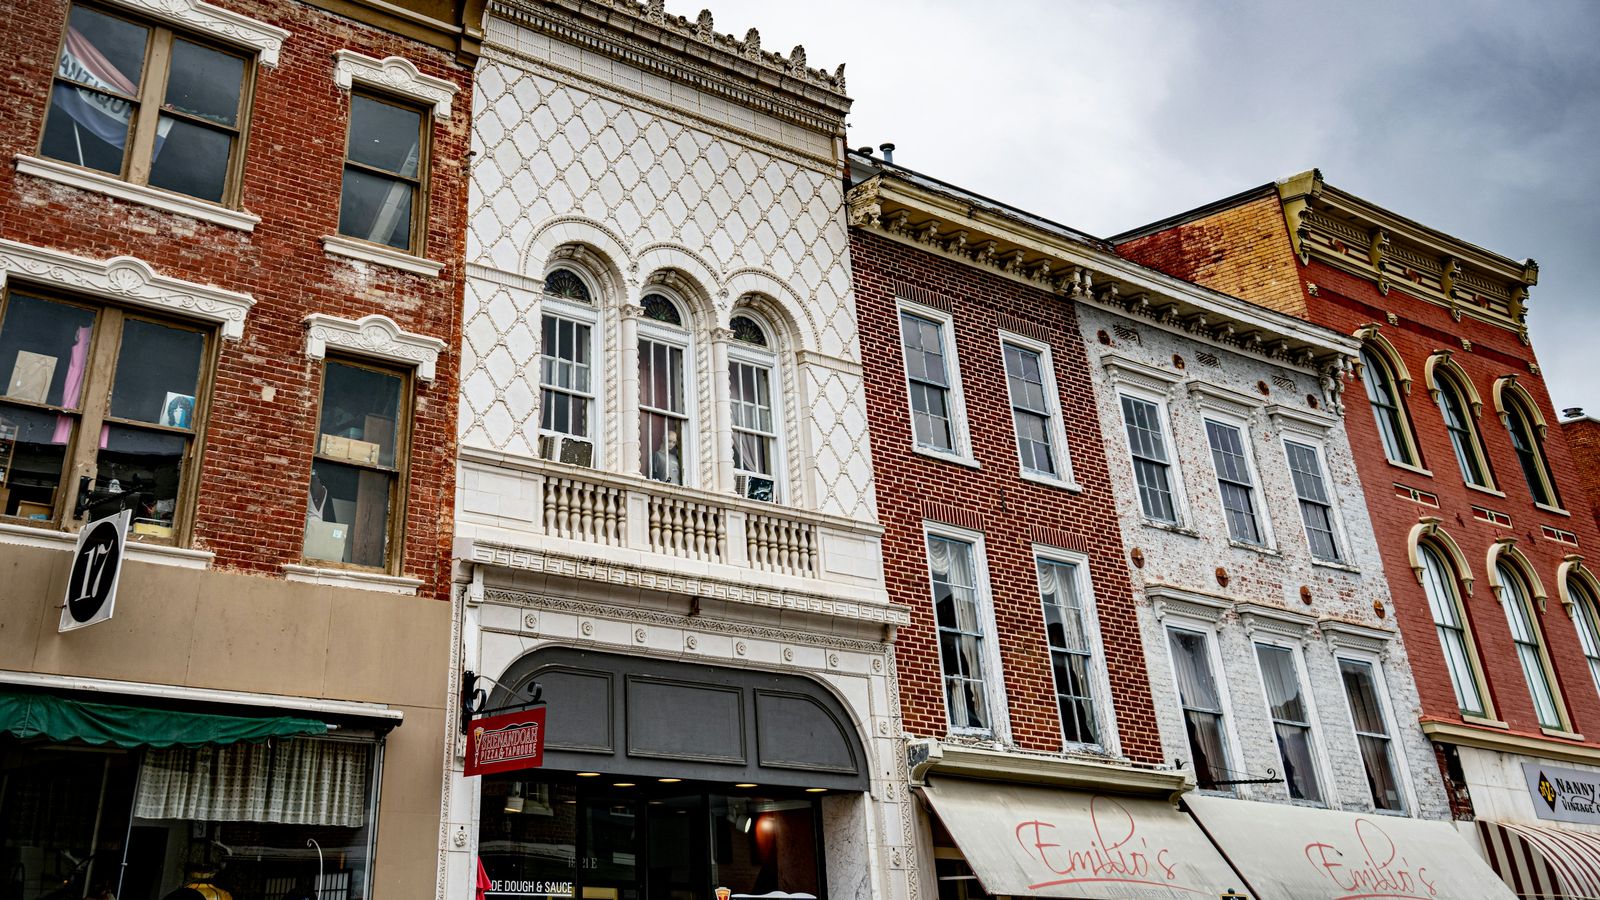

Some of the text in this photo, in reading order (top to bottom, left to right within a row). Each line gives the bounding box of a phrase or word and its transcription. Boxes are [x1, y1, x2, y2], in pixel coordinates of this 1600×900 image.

[74, 539, 114, 602] 17
[481, 727, 538, 750] SHENANDOAH
[480, 743, 537, 760] PIZZA & TAPHOUSE
[1555, 777, 1595, 804] NANNY
[1561, 796, 1595, 814] VINTAGE
[1015, 793, 1177, 880] Emilio's
[1305, 818, 1437, 896] Emilio's
[489, 880, 573, 894] DE DOUGH & SAUCE
